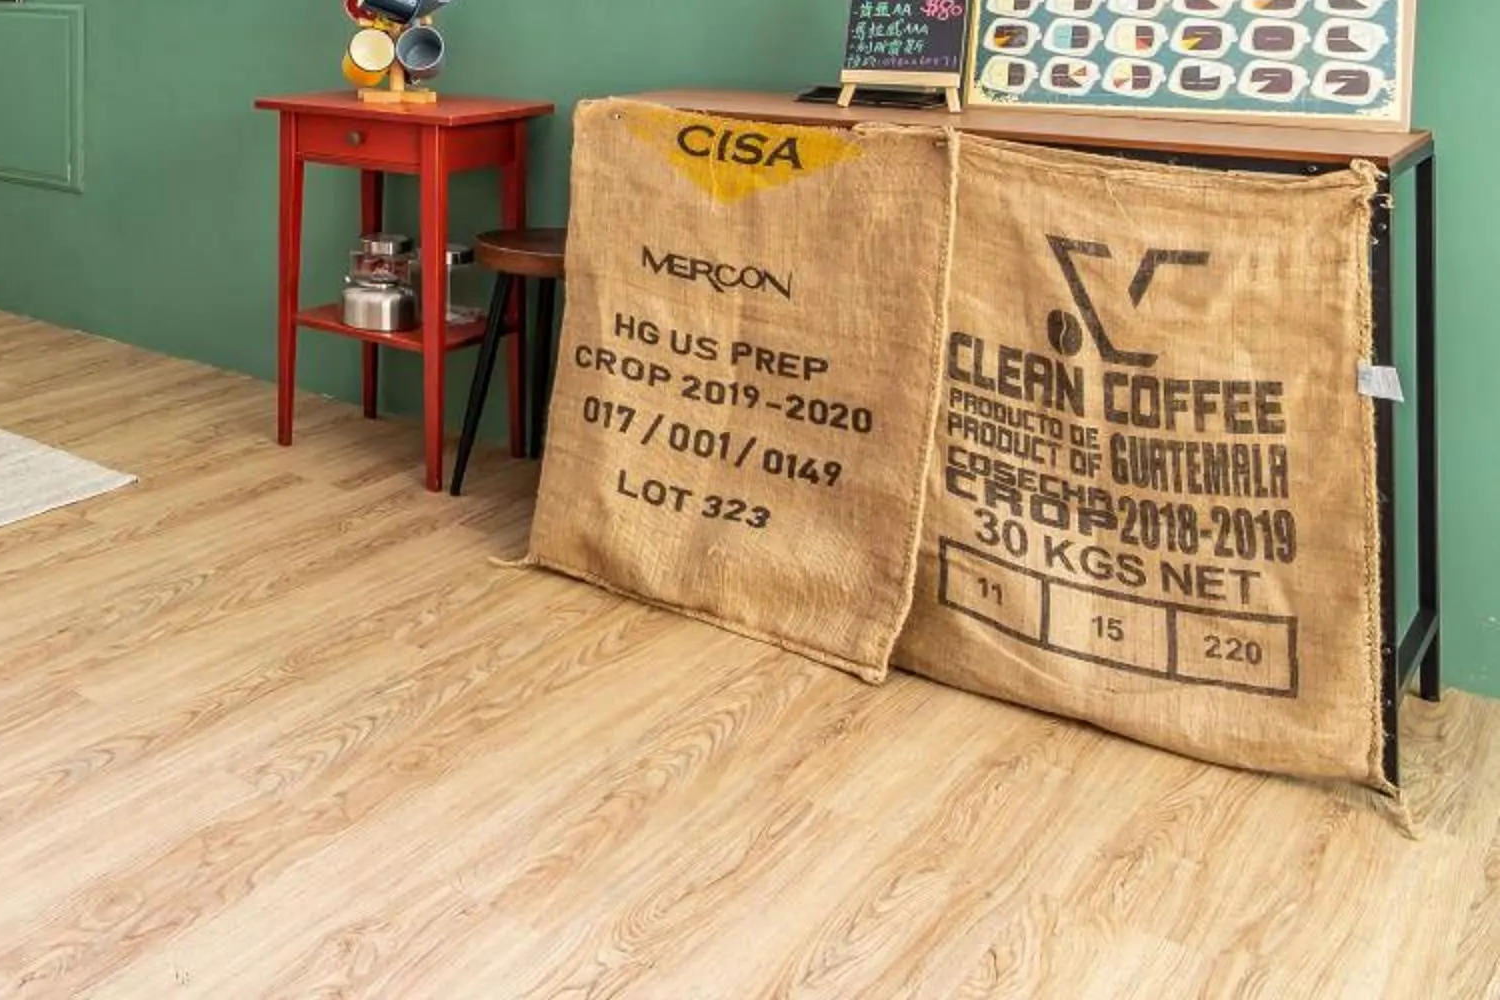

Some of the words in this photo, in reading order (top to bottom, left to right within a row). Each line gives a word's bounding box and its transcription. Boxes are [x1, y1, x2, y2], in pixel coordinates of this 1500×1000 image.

[677, 125, 804, 169] CISA
[642, 246, 793, 301] MERCON
[614, 312, 660, 345] HG
[670, 330, 719, 361] US
[731, 341, 829, 381] PREP
[575, 345, 671, 387] CROP
[681, 375, 873, 434] 2019-2020
[948, 331, 1085, 418] CLEAN
[1103, 371, 1287, 435] COFFEE
[948, 411, 1063, 466] PRODUCT
[1070, 449, 1102, 479] OF
[950, 387, 1063, 441] PRODUCTO
[1070, 423, 1100, 449] DE
[617, 469, 693, 512] LOT
[701, 495, 771, 529] 323
[948, 445, 1114, 512] COSECHA
[1109, 432, 1290, 499] GUATEMALA
[945, 465, 1119, 537] CROP
[1117, 496, 1297, 564] 2018-2019
[973, 507, 1029, 558] 30
[1044, 535, 1147, 588] KGS
[1160, 560, 1261, 605] NET
[977, 577, 1003, 605] 11
[1091, 615, 1125, 642] 15
[1203, 634, 1263, 665] 220
